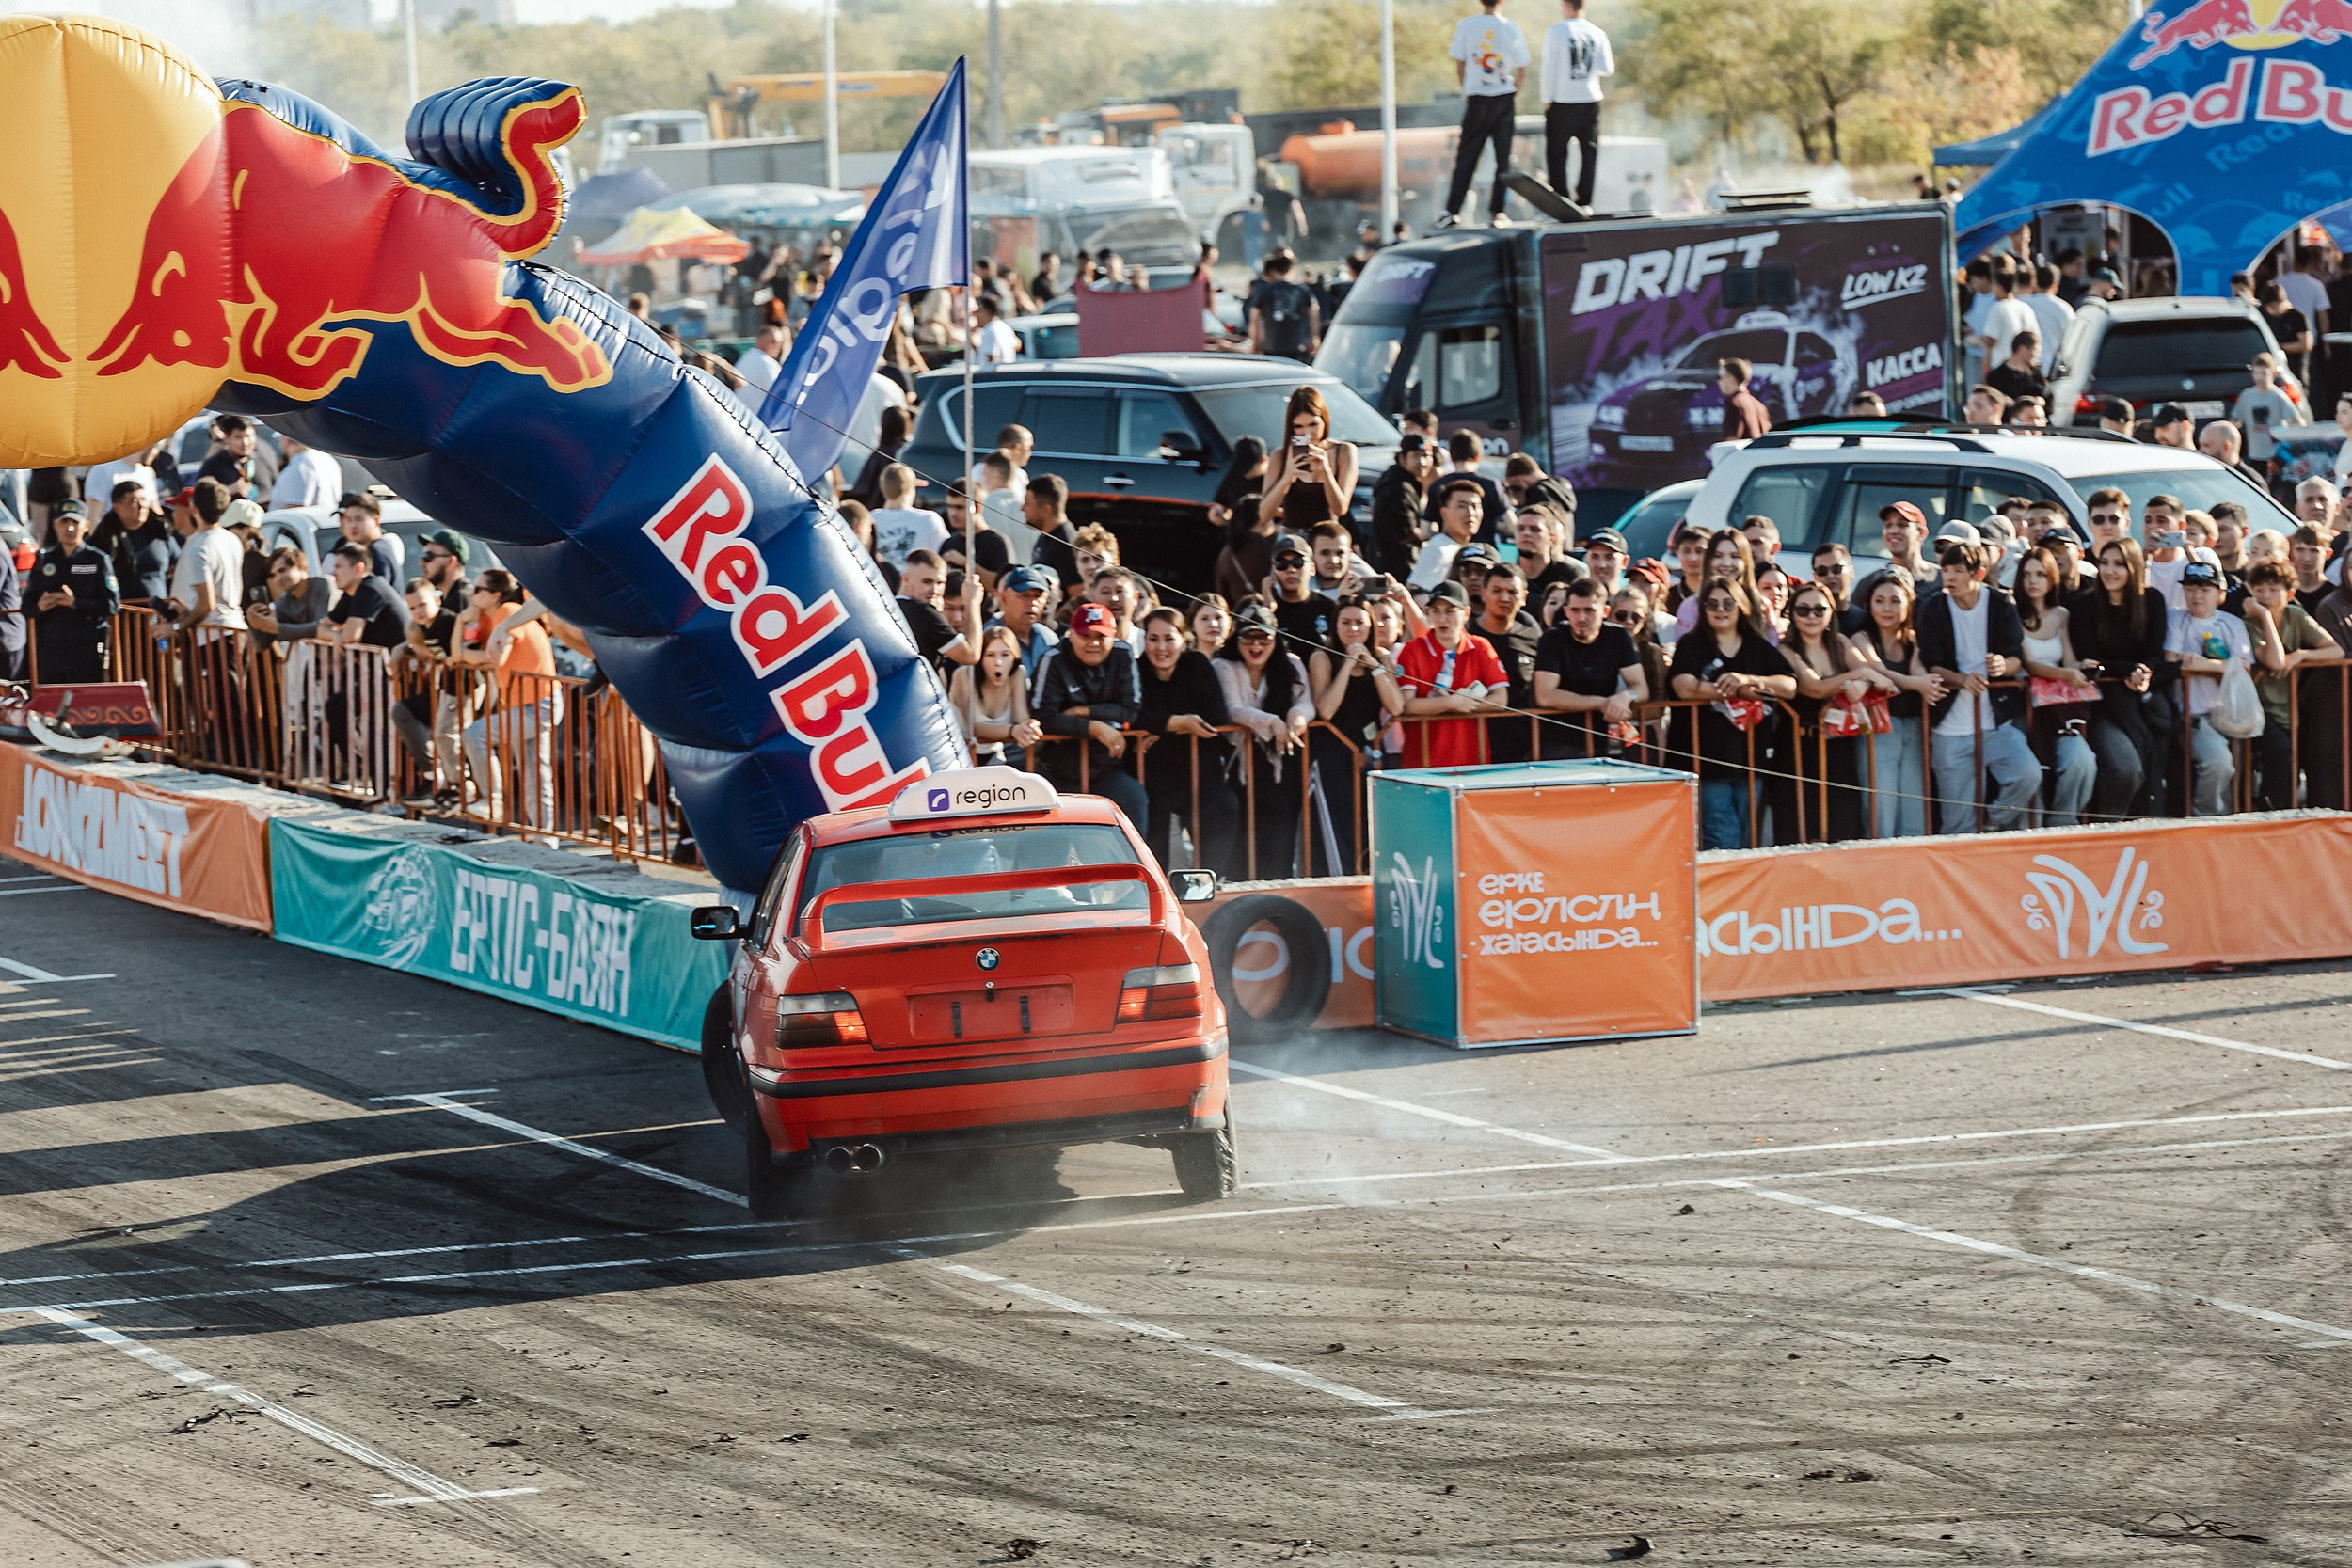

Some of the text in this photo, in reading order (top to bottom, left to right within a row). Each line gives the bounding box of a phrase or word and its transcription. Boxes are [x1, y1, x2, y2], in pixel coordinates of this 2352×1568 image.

[2086, 56, 2256, 158] Red
[2255, 58, 2352, 135] Bu
[1571, 231, 1781, 315] DRIFT
[1840, 263, 1929, 301] LOW KZ
[1867, 342, 1943, 388] КАССА
[641, 452, 933, 812] Red Bul
[956, 784, 1025, 808] region
